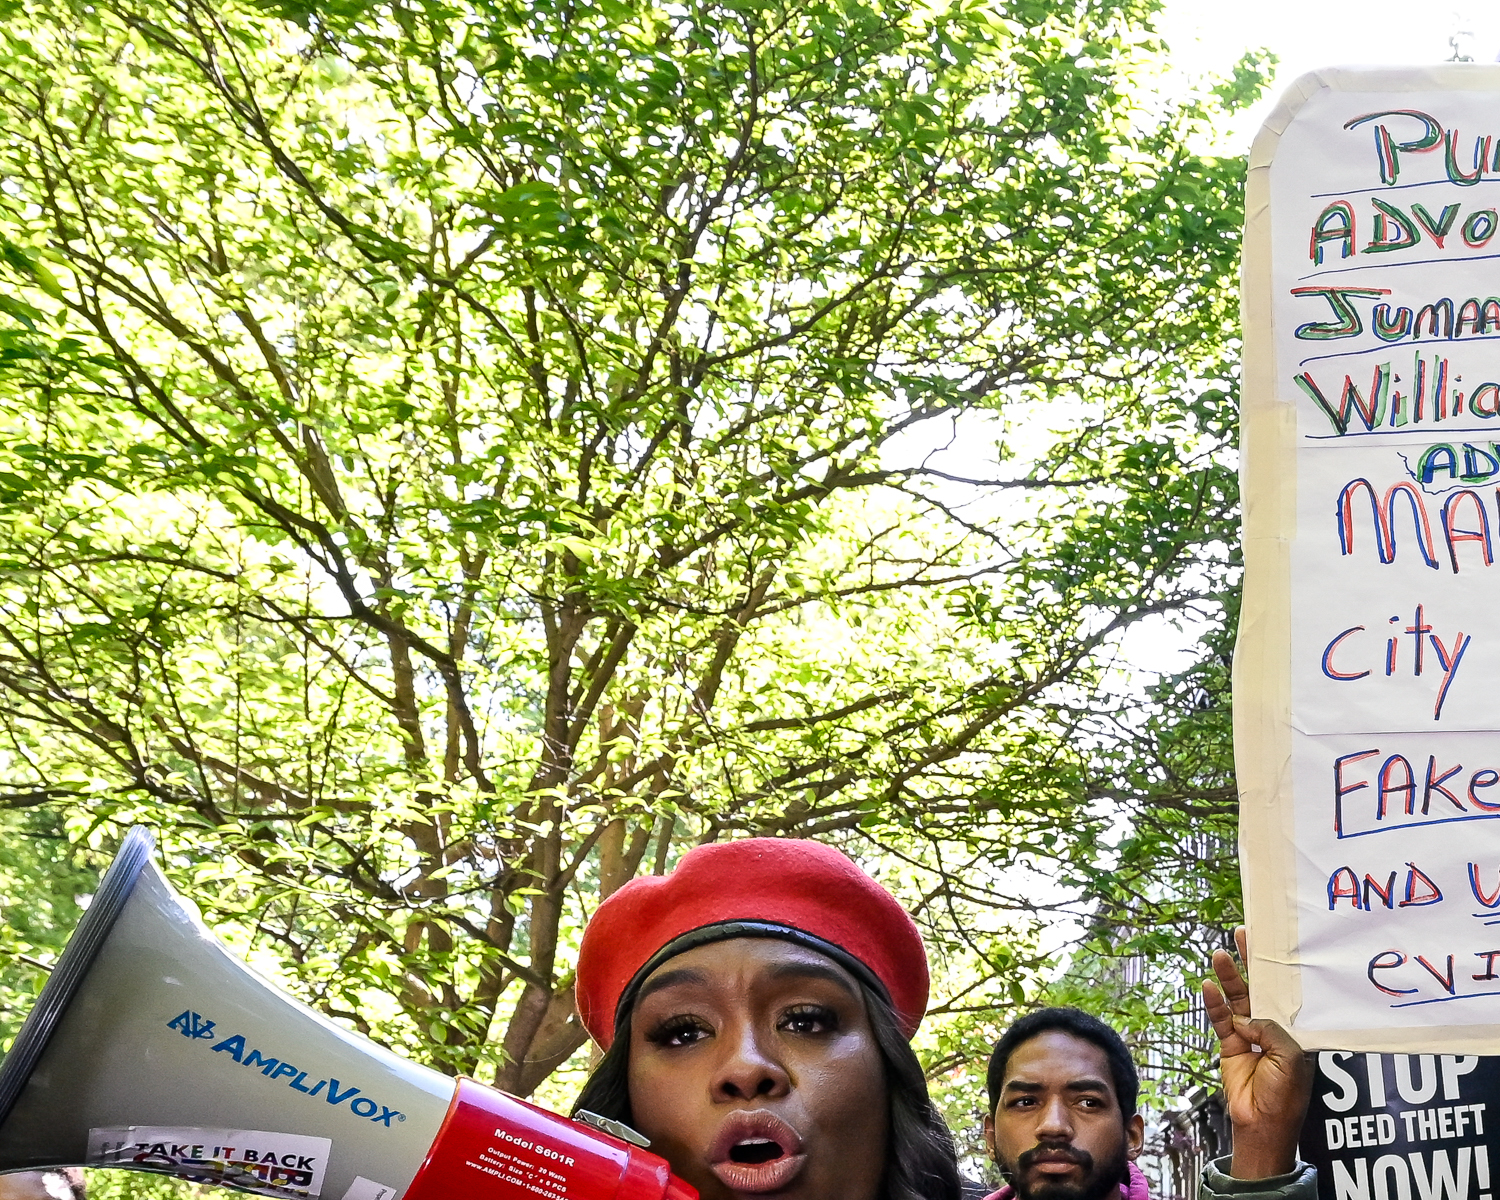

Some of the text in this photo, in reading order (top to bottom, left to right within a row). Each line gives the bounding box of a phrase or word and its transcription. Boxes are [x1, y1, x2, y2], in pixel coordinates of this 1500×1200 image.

[1327, 862, 1443, 912] AND
[1317, 1050, 1480, 1113] STOP
[493, 1128, 576, 1168] Model S601R
[1324, 1102, 1487, 1151] DEED THEFT
[135, 1141, 205, 1160] TAKE
[213, 1146, 236, 1160] IT
[243, 1148, 316, 1171] BACK
